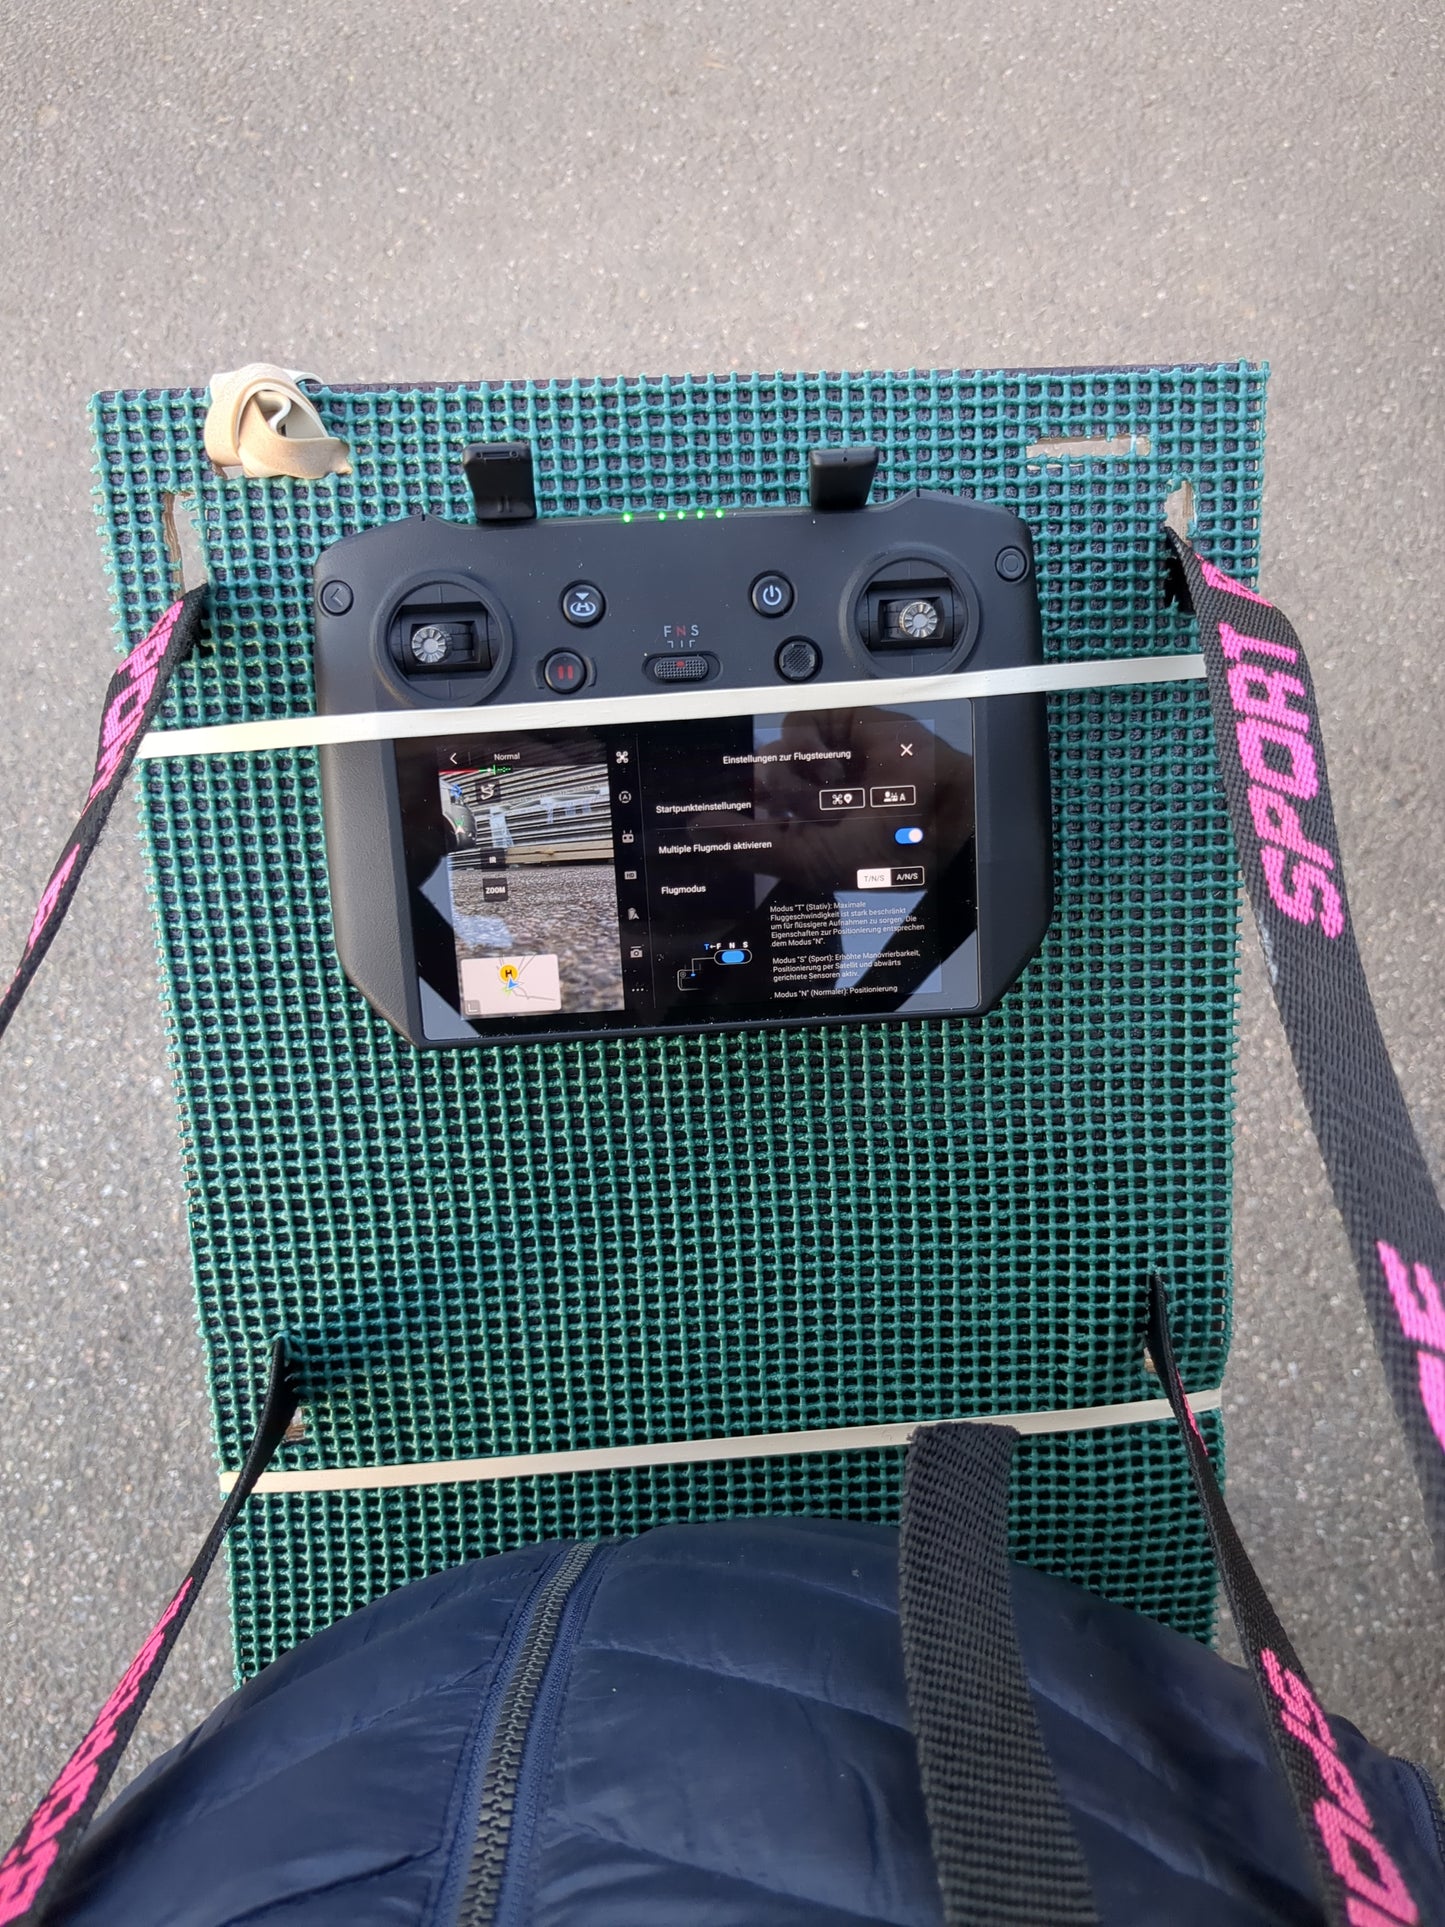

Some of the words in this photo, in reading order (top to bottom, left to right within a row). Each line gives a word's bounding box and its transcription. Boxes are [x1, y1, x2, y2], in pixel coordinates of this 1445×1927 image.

[664, 625, 671, 637] F
[676, 625, 686, 637] N
[691, 624, 699, 636] S
[494, 752, 520, 761] Normal
[723, 754, 777, 765] Einstellungen
[779, 753, 792, 762] zur
[794, 751, 851, 762] Flugsteuerung
[1218, 622, 1345, 940] SPORT
[656, 801, 751, 814] Startpunkteinstellungen
[658, 844, 691, 855] Multiple
[693, 842, 731, 853] Flugmodi
[733, 840, 772, 850] aktivieren
[864, 874, 885, 882] T/N/S
[896, 872, 918, 881] A/N/S
[485, 886, 506, 894] ZOOM
[661, 885, 706, 895] Flugmodus
[770, 905, 793, 913] Modus
[834, 901, 866, 909] Maximale
[770, 911, 839, 922] Fluggeschwindigkeit
[851, 909, 867, 917] stark
[794, 921, 827, 929] flüssigere
[771, 930, 819, 939] Eigenschaften
[833, 926, 881, 936] Positionierung
[883, 924, 924, 933] entsprechen
[788, 938, 811, 946] Modus
[773, 964, 821, 973] Positionierung
[874, 959, 901, 967] abwärts
[773, 973, 807, 983] gerichtete
[809, 971, 840, 979] Sensoren
[774, 990, 798, 998] Modus
[850, 985, 898, 995] Positionierung
